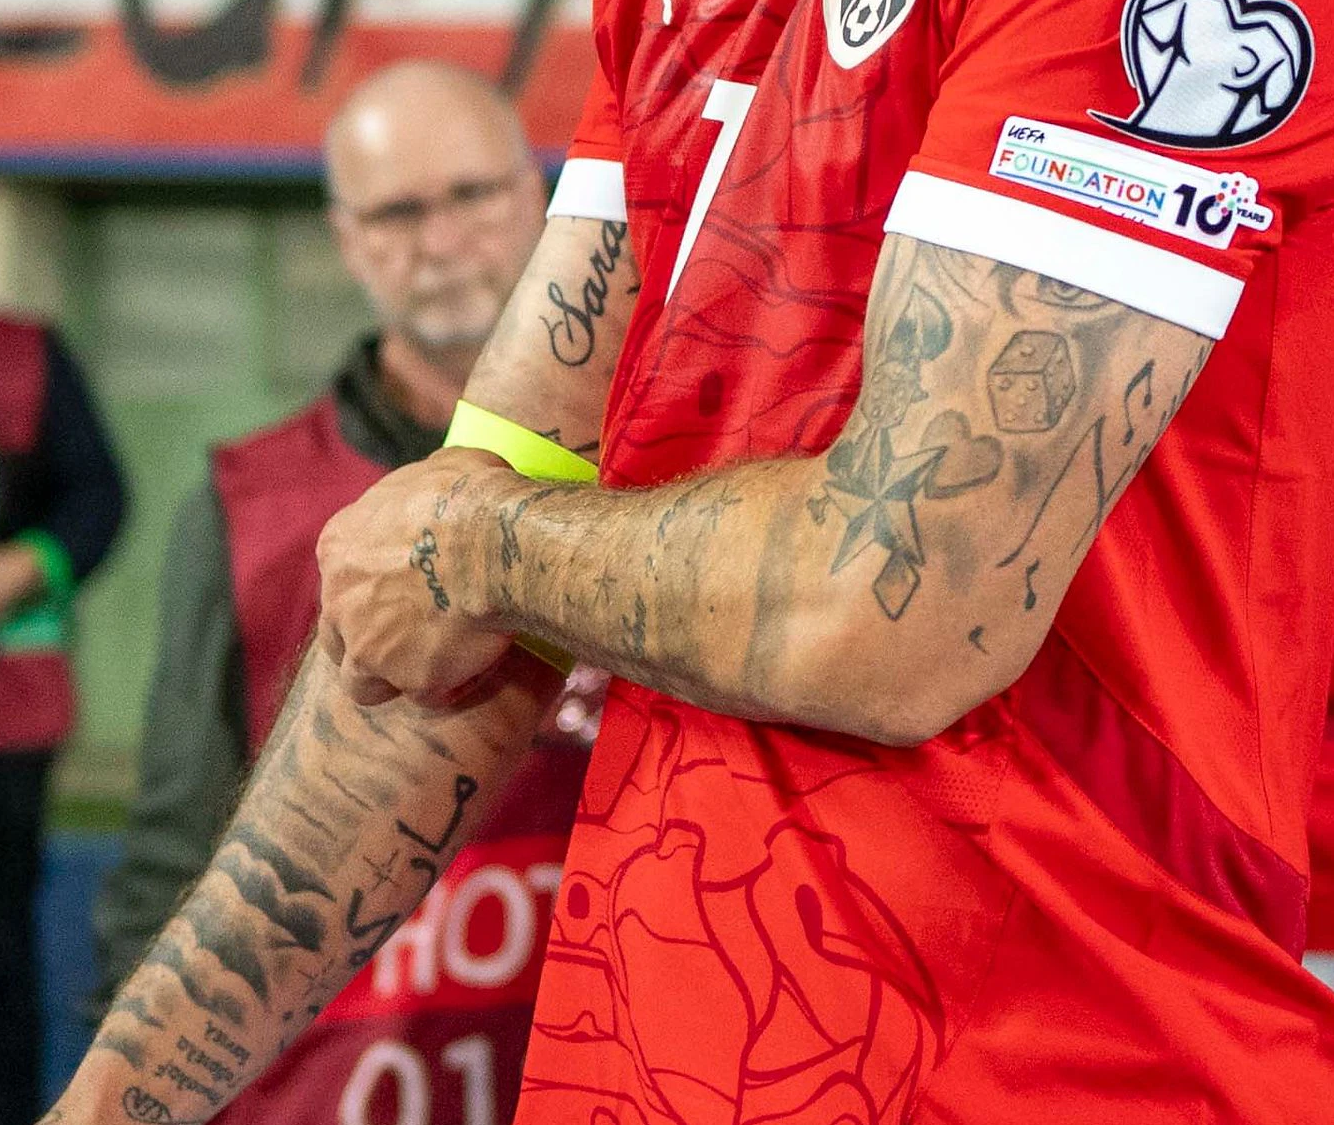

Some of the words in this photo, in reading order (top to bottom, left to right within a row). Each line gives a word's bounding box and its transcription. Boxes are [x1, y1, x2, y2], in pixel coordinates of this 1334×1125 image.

[1007, 124, 1046, 144] UEFA
[1173, 183, 1233, 236] 10
[1236, 207, 1266, 224] YEARS
